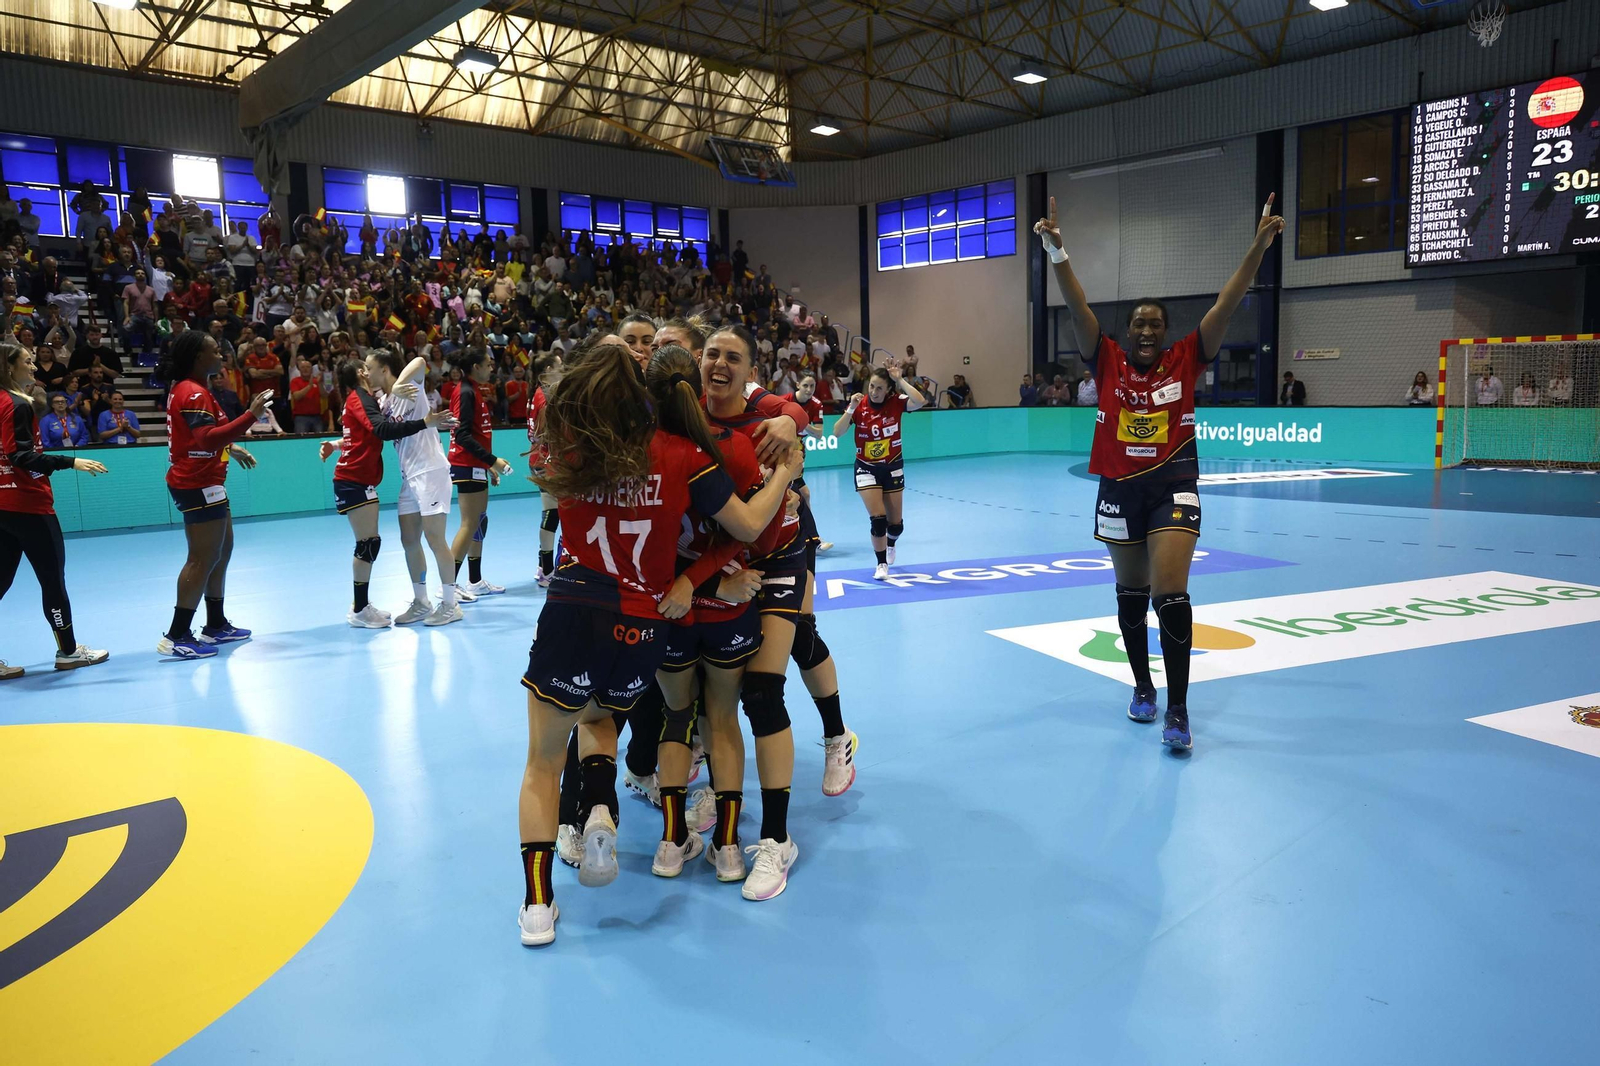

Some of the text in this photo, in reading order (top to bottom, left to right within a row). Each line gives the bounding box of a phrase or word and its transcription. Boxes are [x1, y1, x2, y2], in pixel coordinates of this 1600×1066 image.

[1416, 98, 1515, 124] 6 CAMPOS C. 3
[1417, 88, 1516, 114] 1 WIGGINS N. 0
[1413, 135, 1422, 144] 16
[1425, 126, 1477, 142] CASTELLANOS
[1508, 120, 1514, 129] 0
[1414, 125, 1423, 134] 14
[1456, 118, 1463, 127] O.
[1509, 110, 1514, 118] 0
[1413, 141, 1513, 164] 19 SOMAZA E. 0
[1414, 145, 1422, 154] 17
[1467, 137, 1473, 146] J.
[1508, 130, 1514, 139] 2
[1412, 151, 1513, 174] 23 ARCOS P. 3
[1532, 140, 1573, 167] 23
[1411, 172, 1511, 194] 33 GASSAMA K. 1
[1412, 162, 1512, 184] 27 SO DELGADO D. 8
[1411, 194, 1421, 204] 34
[1467, 188, 1475, 196] A.
[1506, 182, 1511, 191] 3
[1411, 204, 1421, 213] 52
[1447, 200, 1454, 209] P.
[1505, 193, 1510, 202] 0
[1411, 204, 1510, 223] 53 MBENGUE S. 0
[1585, 204, 1600, 219] 2
[1410, 214, 1510, 232] 58 PRIETO M. 0
[1410, 224, 1509, 242] 65 ERAUSKIN A. 3
[1409, 234, 1509, 252] 68 TCHAPCHET L. 0
[1409, 245, 1508, 263] 70 ARROYO C. 0
[872, 424, 879, 437] 6
[1237, 422, 1322, 446] Igualdad
[1099, 500, 1120, 514] AON
[586, 516, 652, 584] 17
